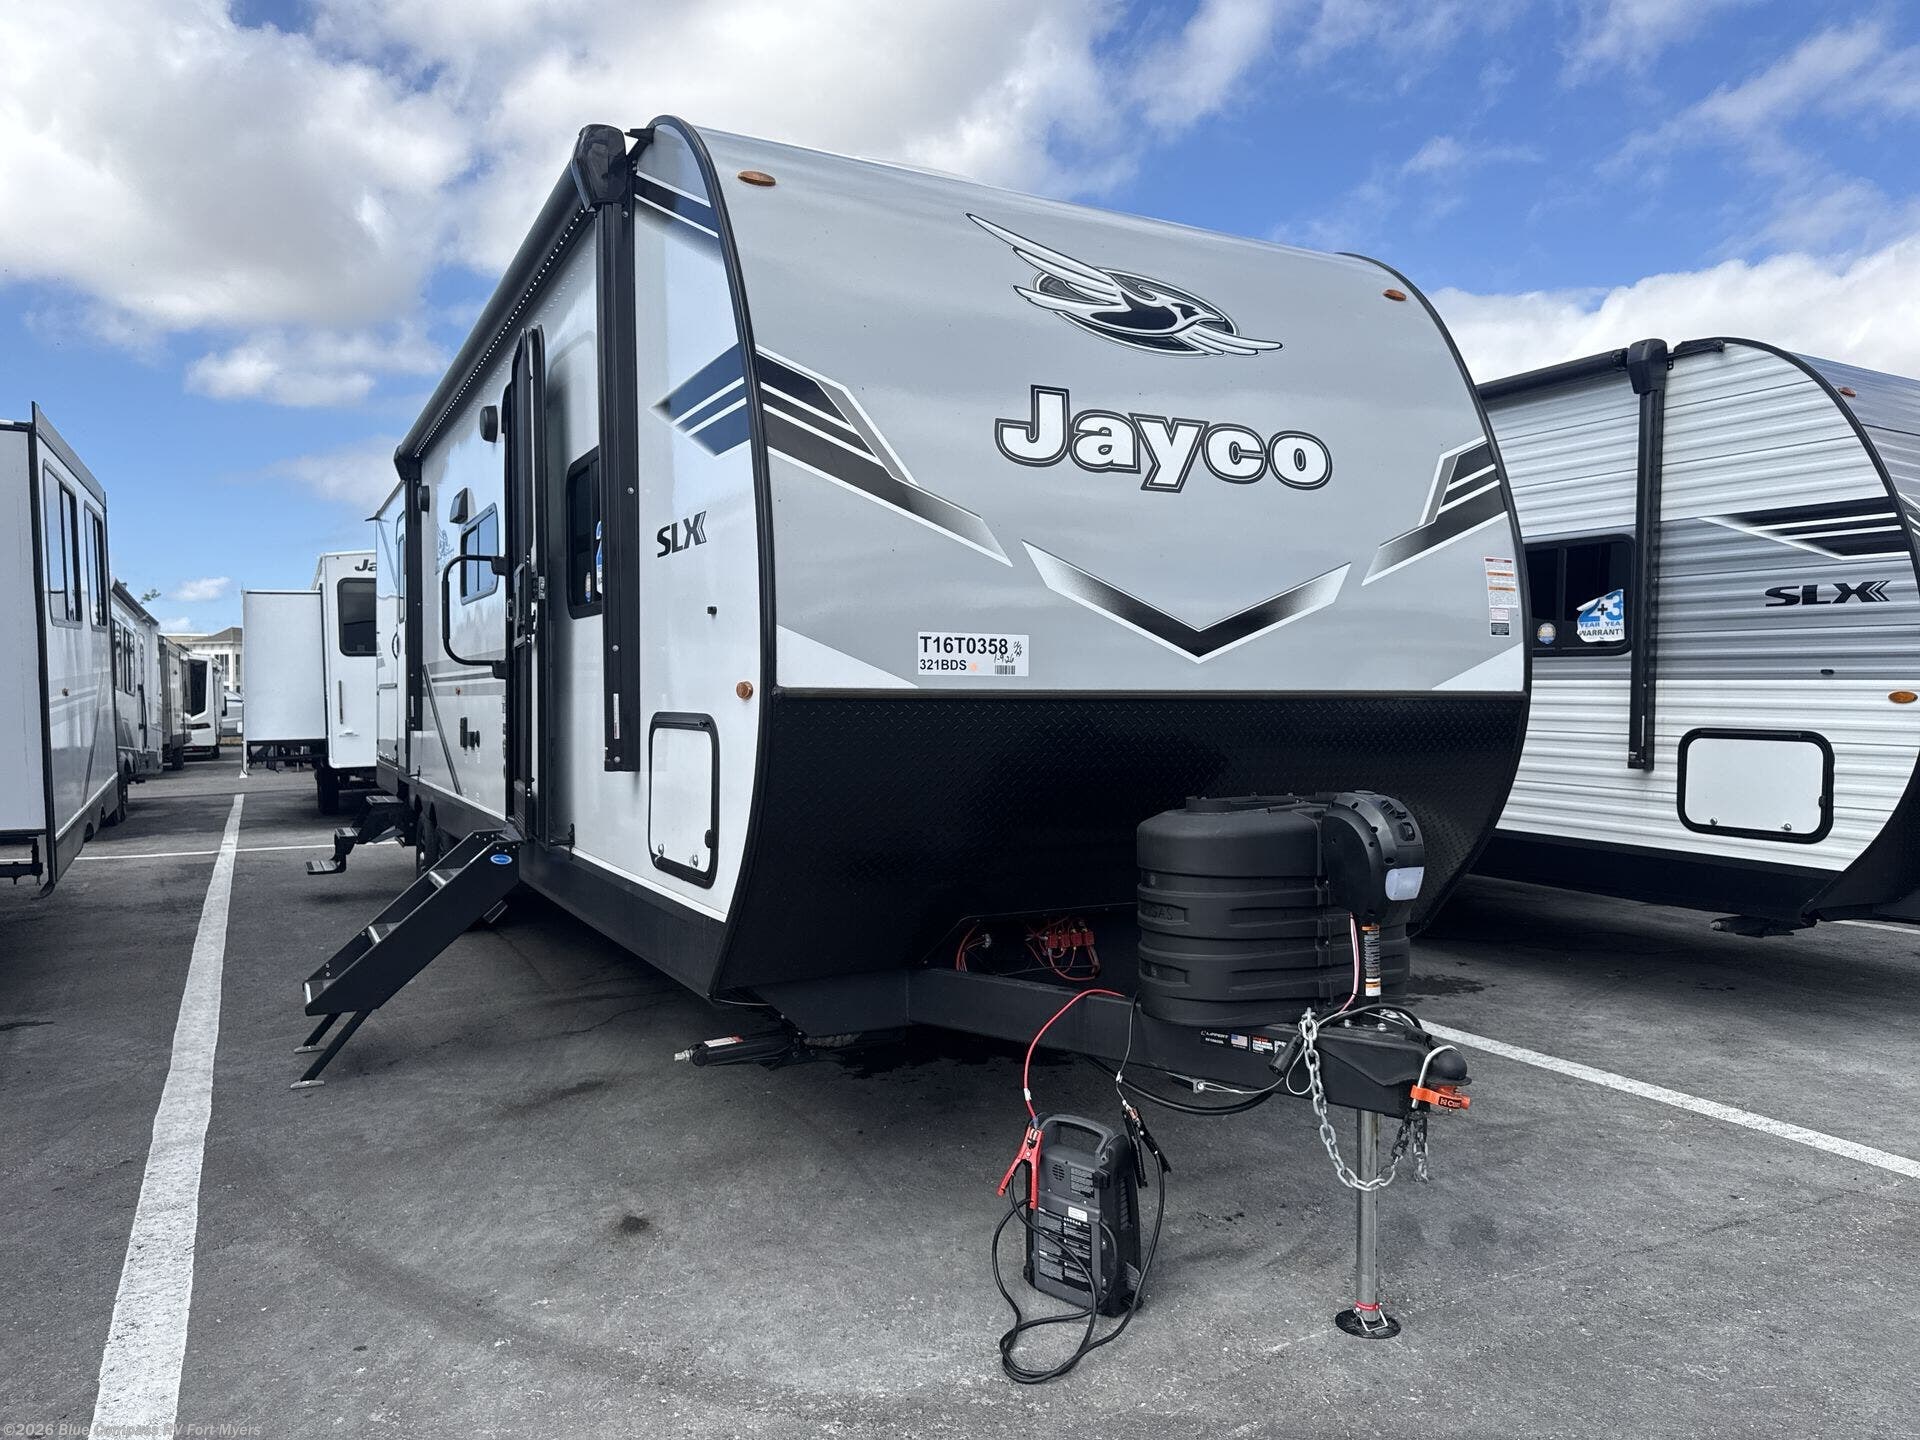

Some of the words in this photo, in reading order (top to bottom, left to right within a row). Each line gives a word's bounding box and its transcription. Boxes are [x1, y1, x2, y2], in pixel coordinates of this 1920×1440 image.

[994, 384, 1333, 493] Jayco
[656, 510, 707, 558] SLX
[1764, 579, 1891, 607] SLX
[919, 636, 1008, 655] T16T0358
[919, 659, 967, 671] 321BDS
